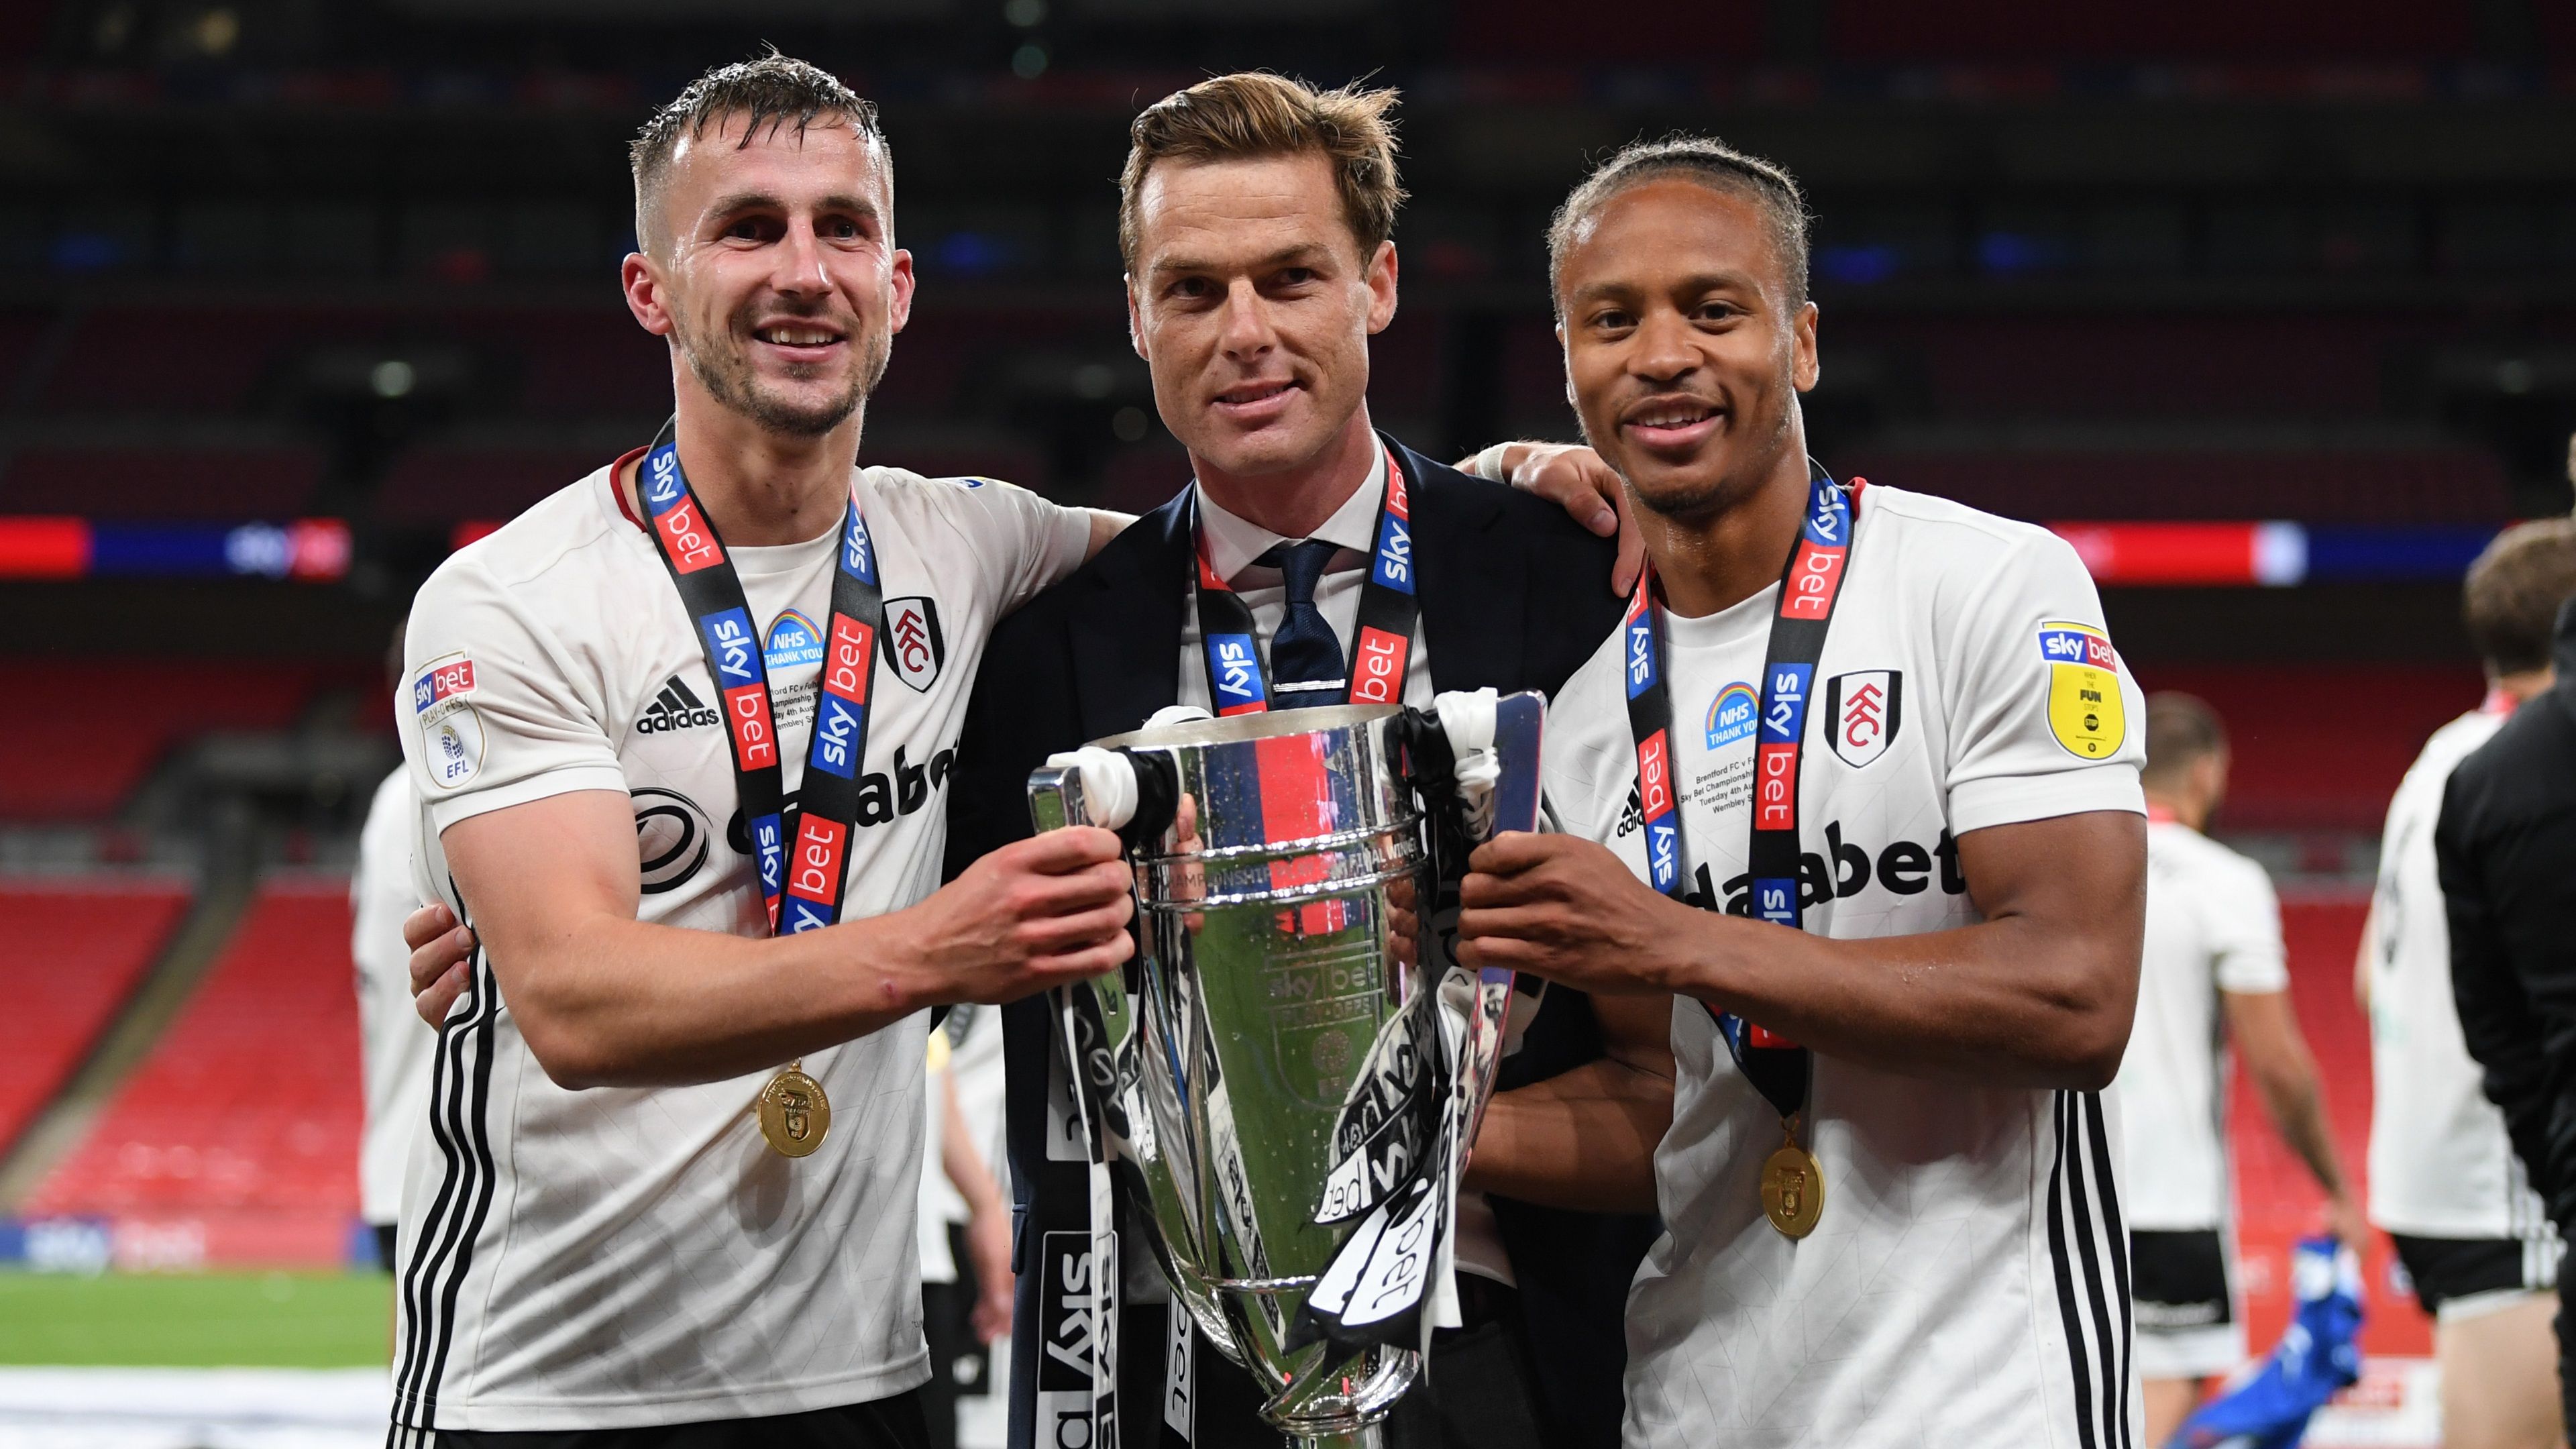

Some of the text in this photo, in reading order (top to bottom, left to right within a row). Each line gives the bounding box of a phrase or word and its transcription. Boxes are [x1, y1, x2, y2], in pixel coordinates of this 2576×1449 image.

[651, 451, 713, 564] sky bet
[847, 510, 869, 574] sky
[1381, 521, 1411, 583] sky
[1794, 485, 1845, 610] sky bet
[765, 647, 823, 666] THANK YOU
[773, 631, 806, 650] NHS
[895, 608, 929, 673] FFC
[1630, 627, 1650, 685] sky
[2046, 633, 2114, 665] sky bet
[416, 665, 470, 706] sky bet
[790, 684, 798, 693] FC
[1219, 642, 1254, 698] sky
[1355, 638, 1395, 702] bet
[714, 619, 770, 761] sky bet
[820, 625, 863, 767] sky bet
[2080, 689, 2102, 703] FUN
[422, 696, 464, 726] PLAY-OFFS
[637, 708, 719, 735] adidas
[777, 718, 804, 731] embley
[786, 708, 798, 716] 4th
[1720, 702, 1750, 727] NHS
[1845, 683, 1882, 747] FFC
[2085, 718, 2098, 727] STOP
[1710, 718, 1758, 745] THANK YO
[1764, 673, 1802, 820] sky bet
[446, 759, 469, 779] EFL
[1680, 794, 1692, 804] Sky
[1694, 788, 1705, 797] Bet
[1706, 769, 1753, 792] Championshi
[1696, 766, 1728, 784] Brentford
[1730, 762, 1739, 771] FC
[1643, 743, 1674, 885] sky bet
[1700, 791, 1728, 806] Tuesday
[1713, 800, 1745, 814] Wembley
[759, 825, 780, 888] sky
[794, 825, 833, 894] bet
[1372, 1202, 1433, 1309] bet
